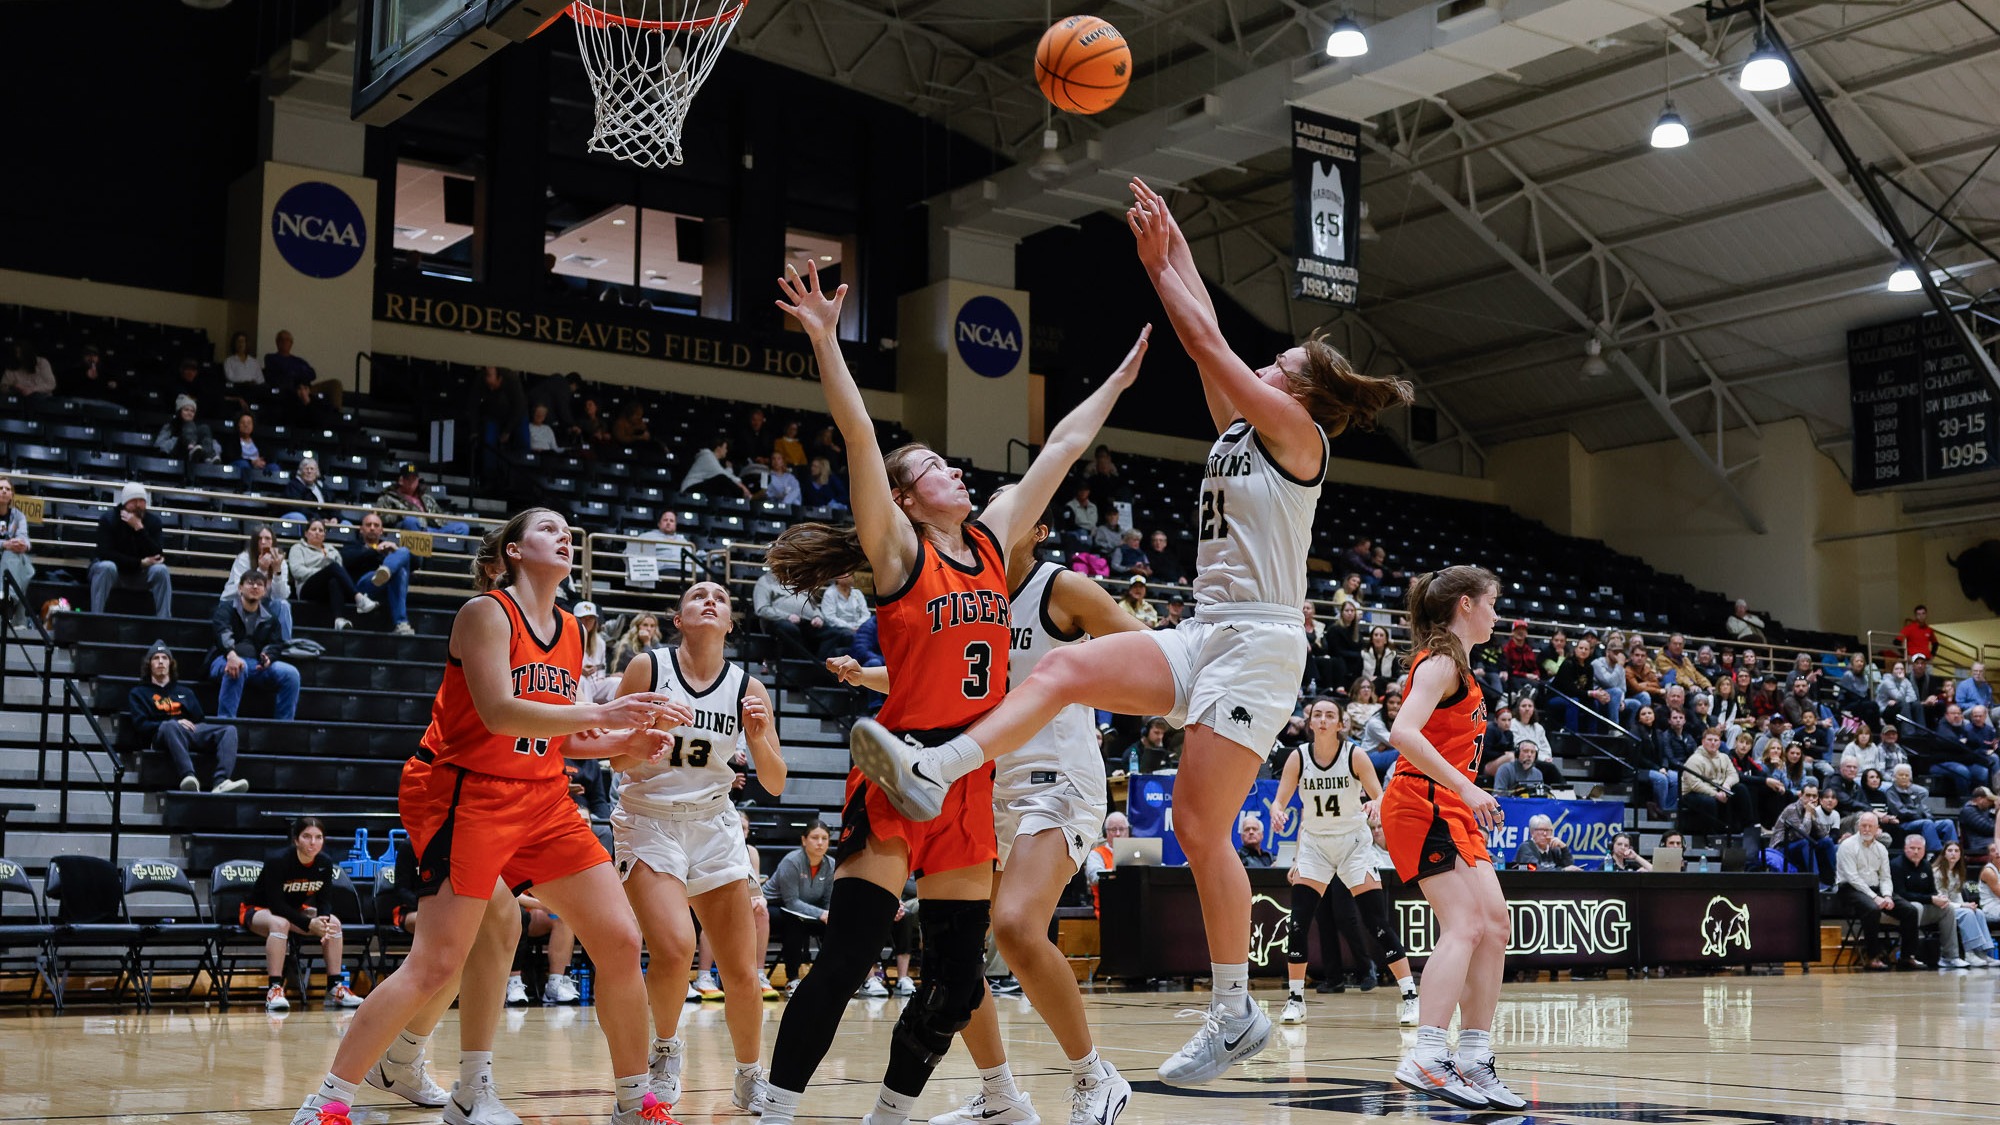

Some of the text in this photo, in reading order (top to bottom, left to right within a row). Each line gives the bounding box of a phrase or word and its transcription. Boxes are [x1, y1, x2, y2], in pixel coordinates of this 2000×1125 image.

[277, 211, 360, 248] NCAA
[1315, 211, 1339, 237] 45
[1301, 276, 1357, 304] 1993-1997
[385, 292, 651, 354] RHODES-REAVES
[663, 333, 751, 369] FIELD
[958, 321, 1019, 352] NCAA
[1853, 382, 1919, 403] CHAMPIONS
[1943, 389, 1992, 410] REGIONA
[1938, 412, 1986, 438] 39-15
[1940, 441, 1988, 469] 1995
[1875, 465, 1900, 480] 1994
[14, 500, 42, 518] SITOR
[1200, 489, 1229, 541] 21
[400, 535, 431, 553] VISITOR
[926, 590, 1011, 634] TIGER
[961, 640, 992, 700] 3
[693, 708, 736, 737] DING
[669, 735, 712, 767] 13
[1303, 775, 1350, 790] HARDING
[1314, 794, 1341, 817] 14
[0, 862, 16, 877] ity
[147, 864, 178, 878] Unity
[237, 865, 262, 878] Unit
[283, 880, 324, 893] TIGERS
[1394, 898, 1631, 957] HDING
